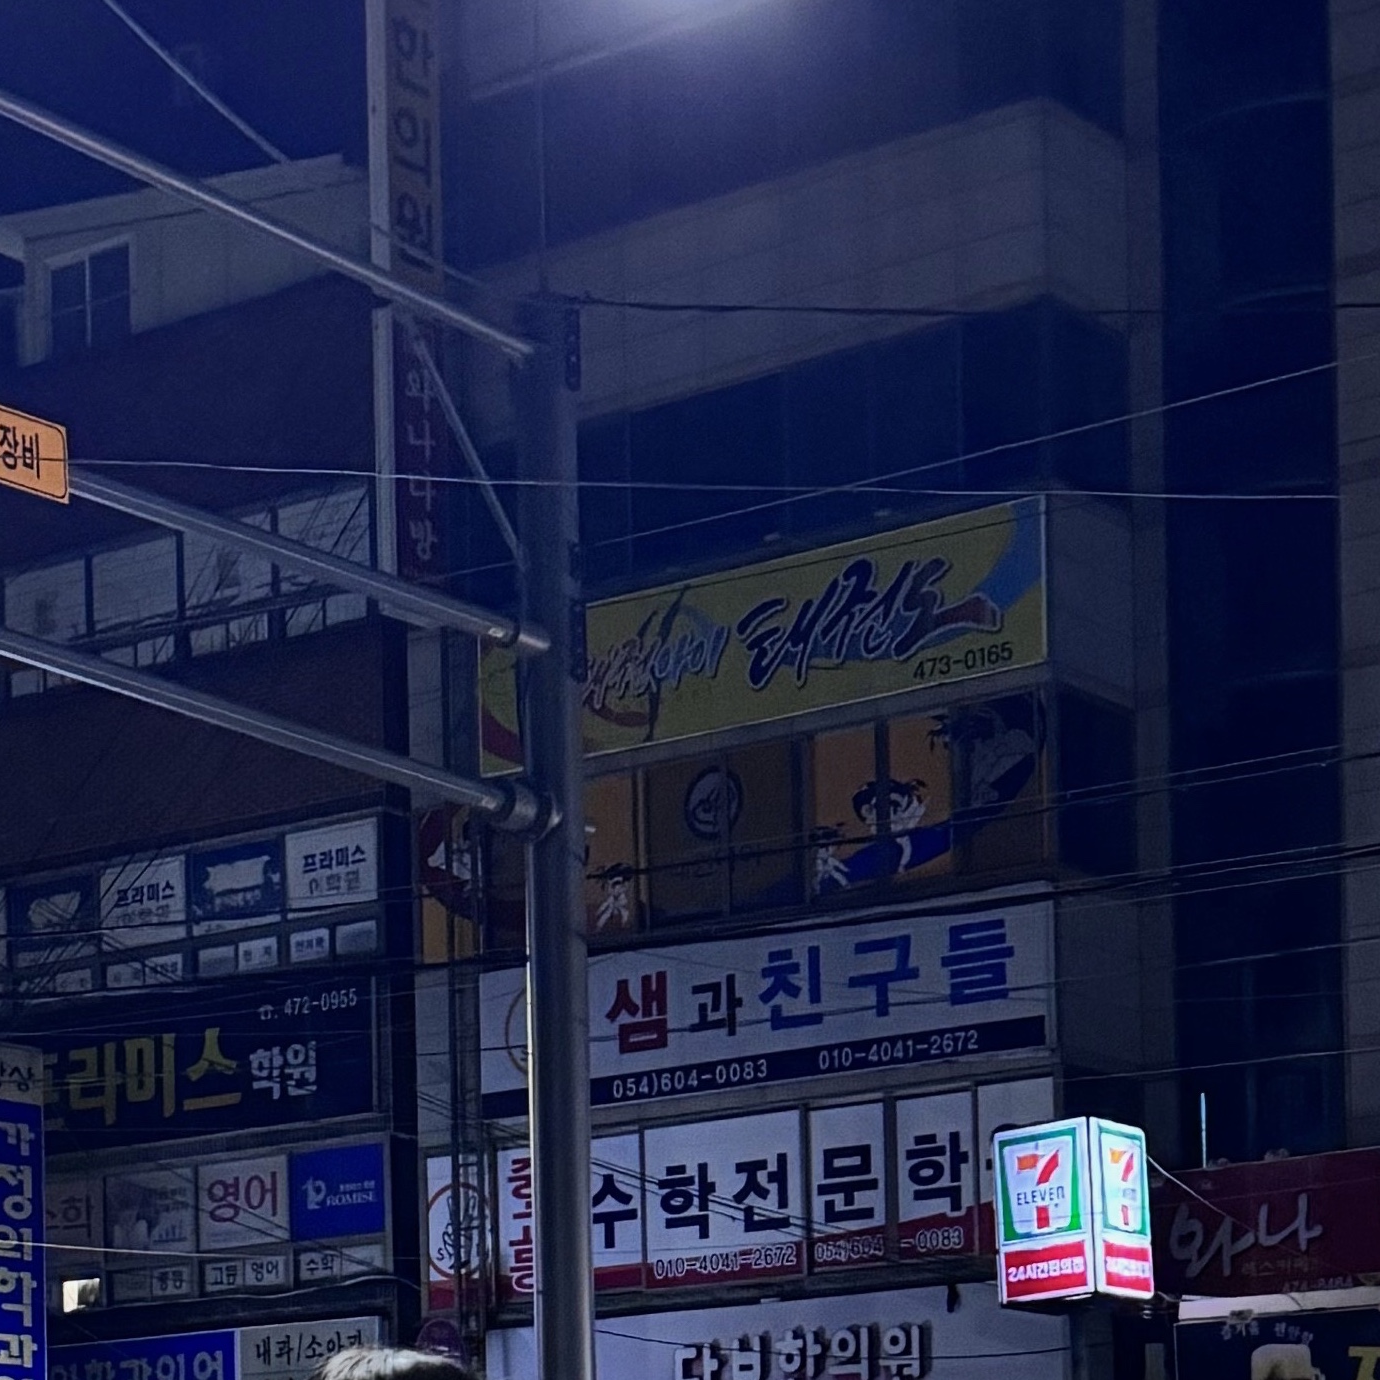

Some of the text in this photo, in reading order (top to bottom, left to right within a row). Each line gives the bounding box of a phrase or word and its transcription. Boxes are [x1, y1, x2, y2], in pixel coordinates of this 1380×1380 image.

[913, 643, 1014, 681] 473-0165
[303, 845, 366, 874] 프라미스
[284, 988, 358, 1018] 472-0955
[248, 1040, 319, 1101] 학원
[612, 1030, 979, 1099] 054)604-0083 010-4041-2672
[207, 1169, 278, 1224] 영어
[250, 1257, 281, 1282] 영어
[653, 1243, 797, 1279] 010-4041-2672
